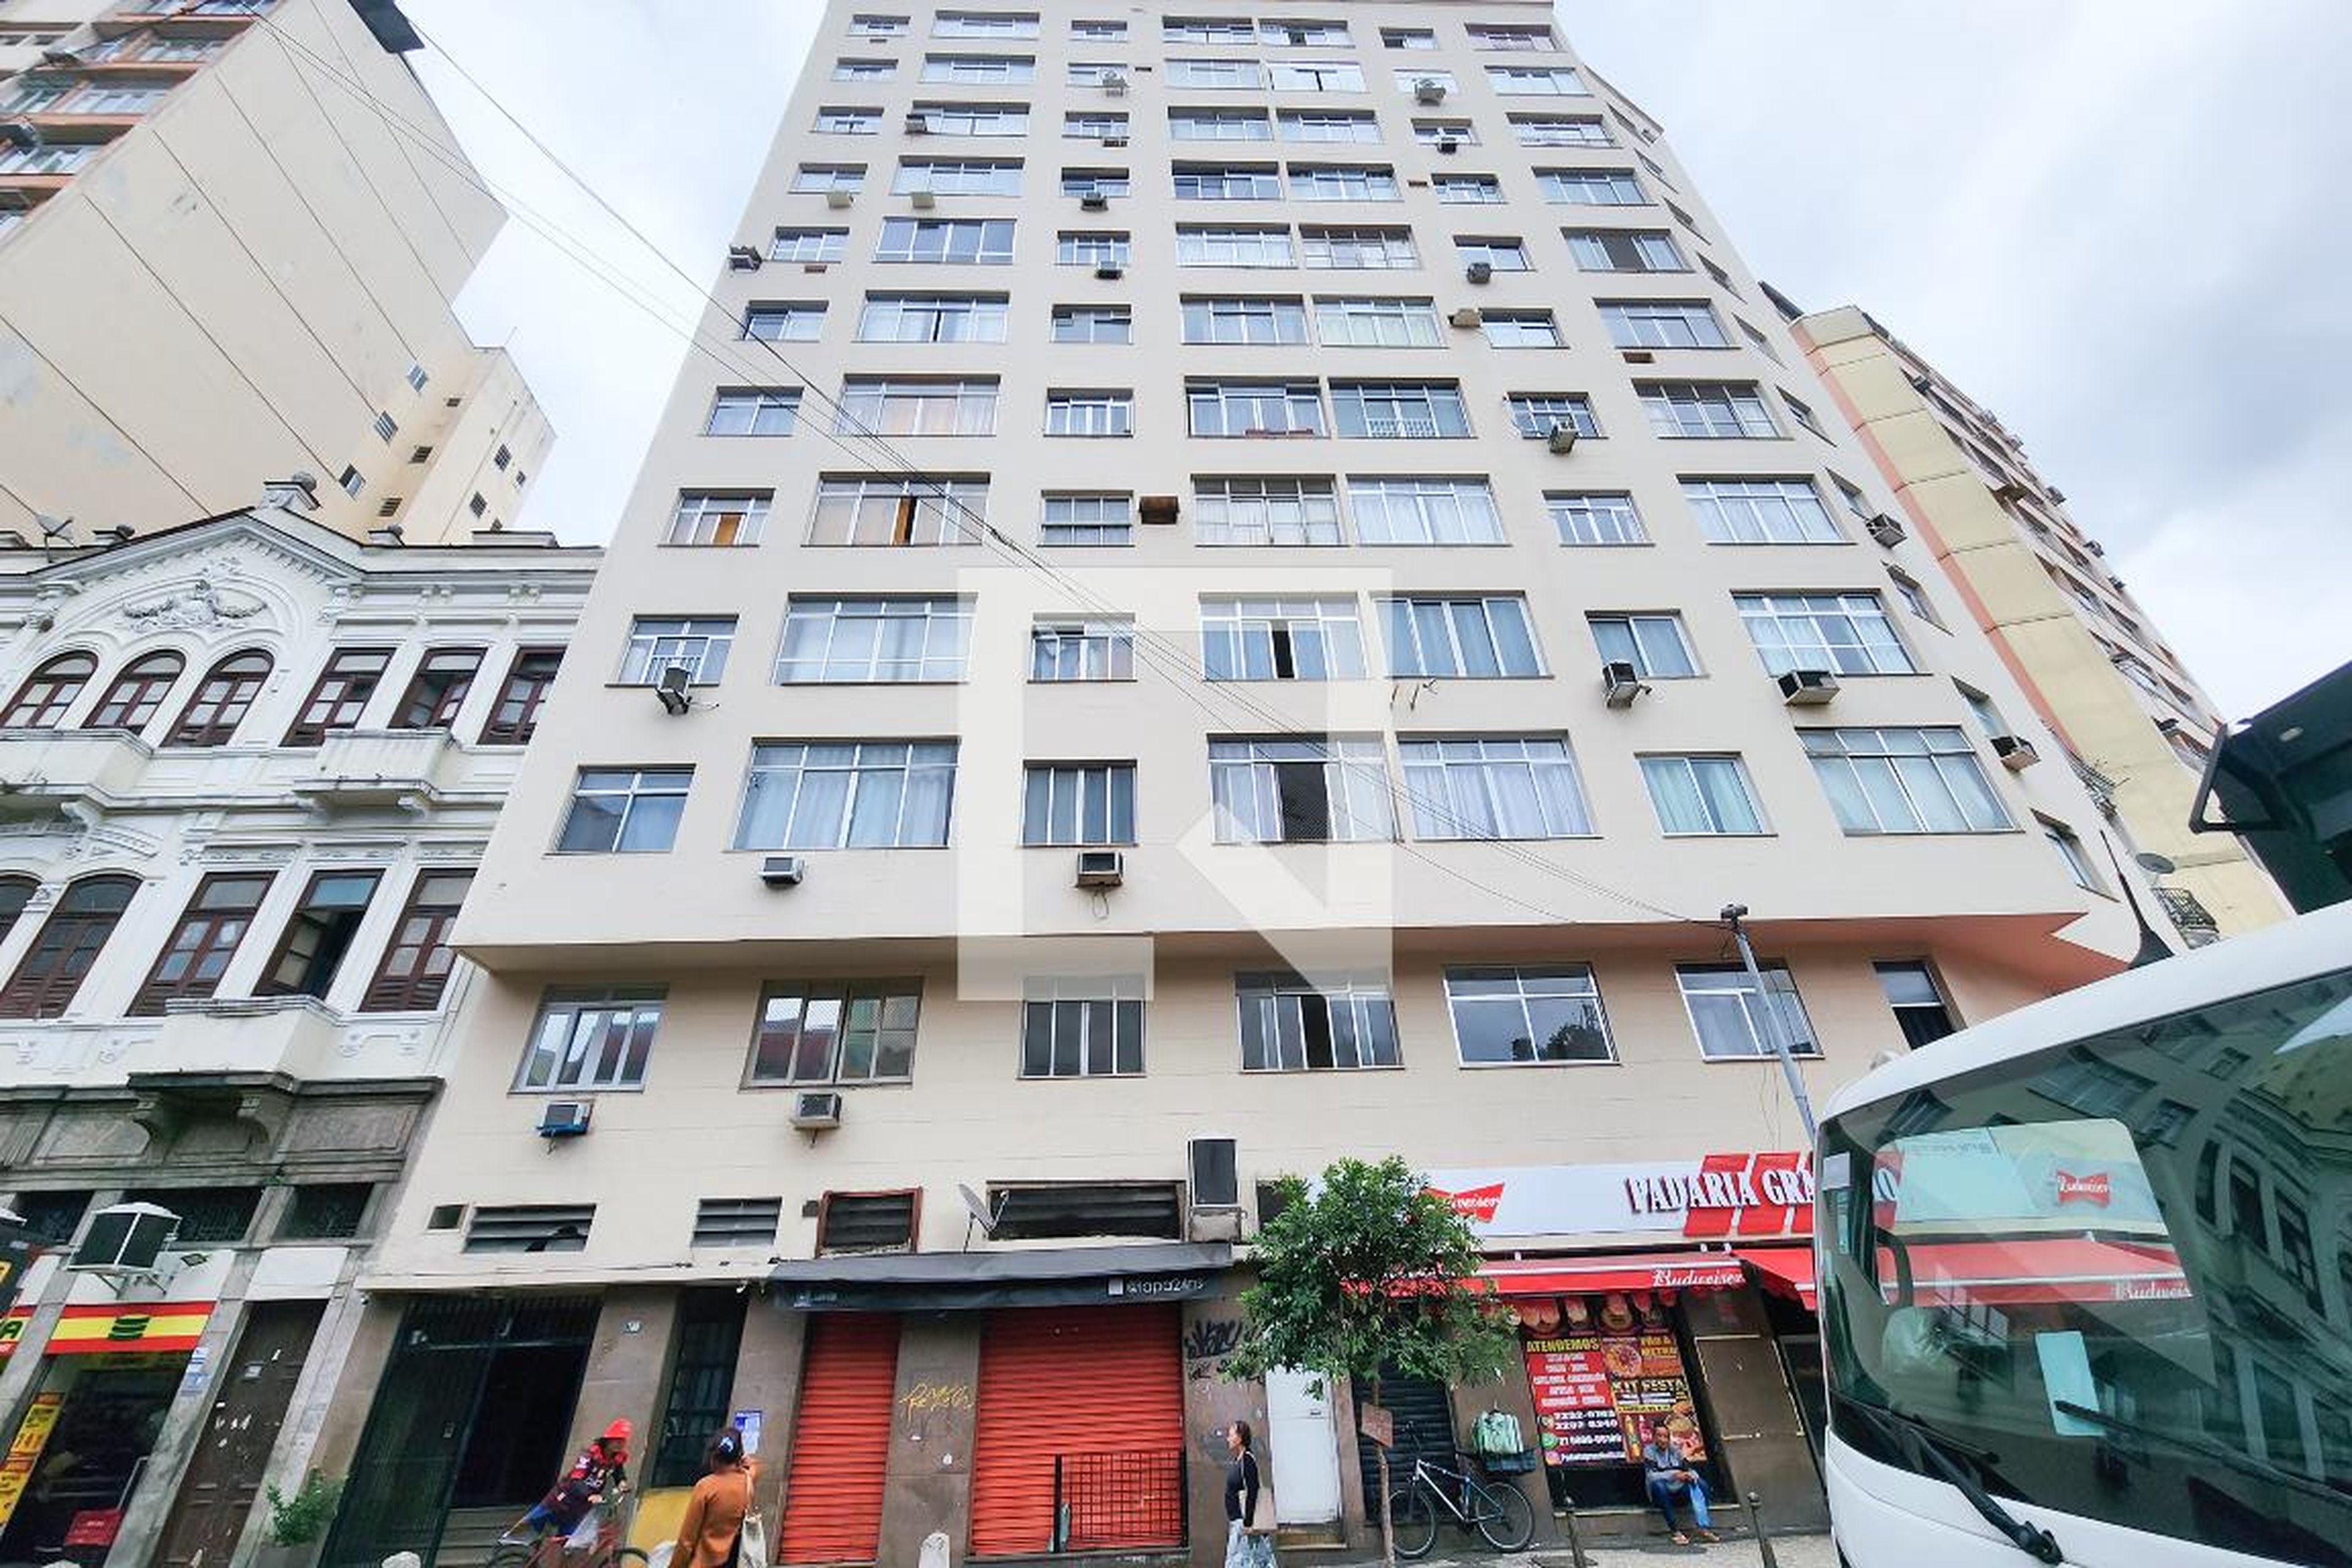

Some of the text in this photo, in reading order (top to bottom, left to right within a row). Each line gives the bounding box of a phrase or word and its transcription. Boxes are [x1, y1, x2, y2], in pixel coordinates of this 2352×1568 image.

[1624, 1170, 1761, 1213] PADARIA
[1651, 1268, 1747, 1287] Budweiser
[1526, 1337, 1599, 1353] ATENDEMOS
[1640, 1378, 1688, 1392] FESTA
